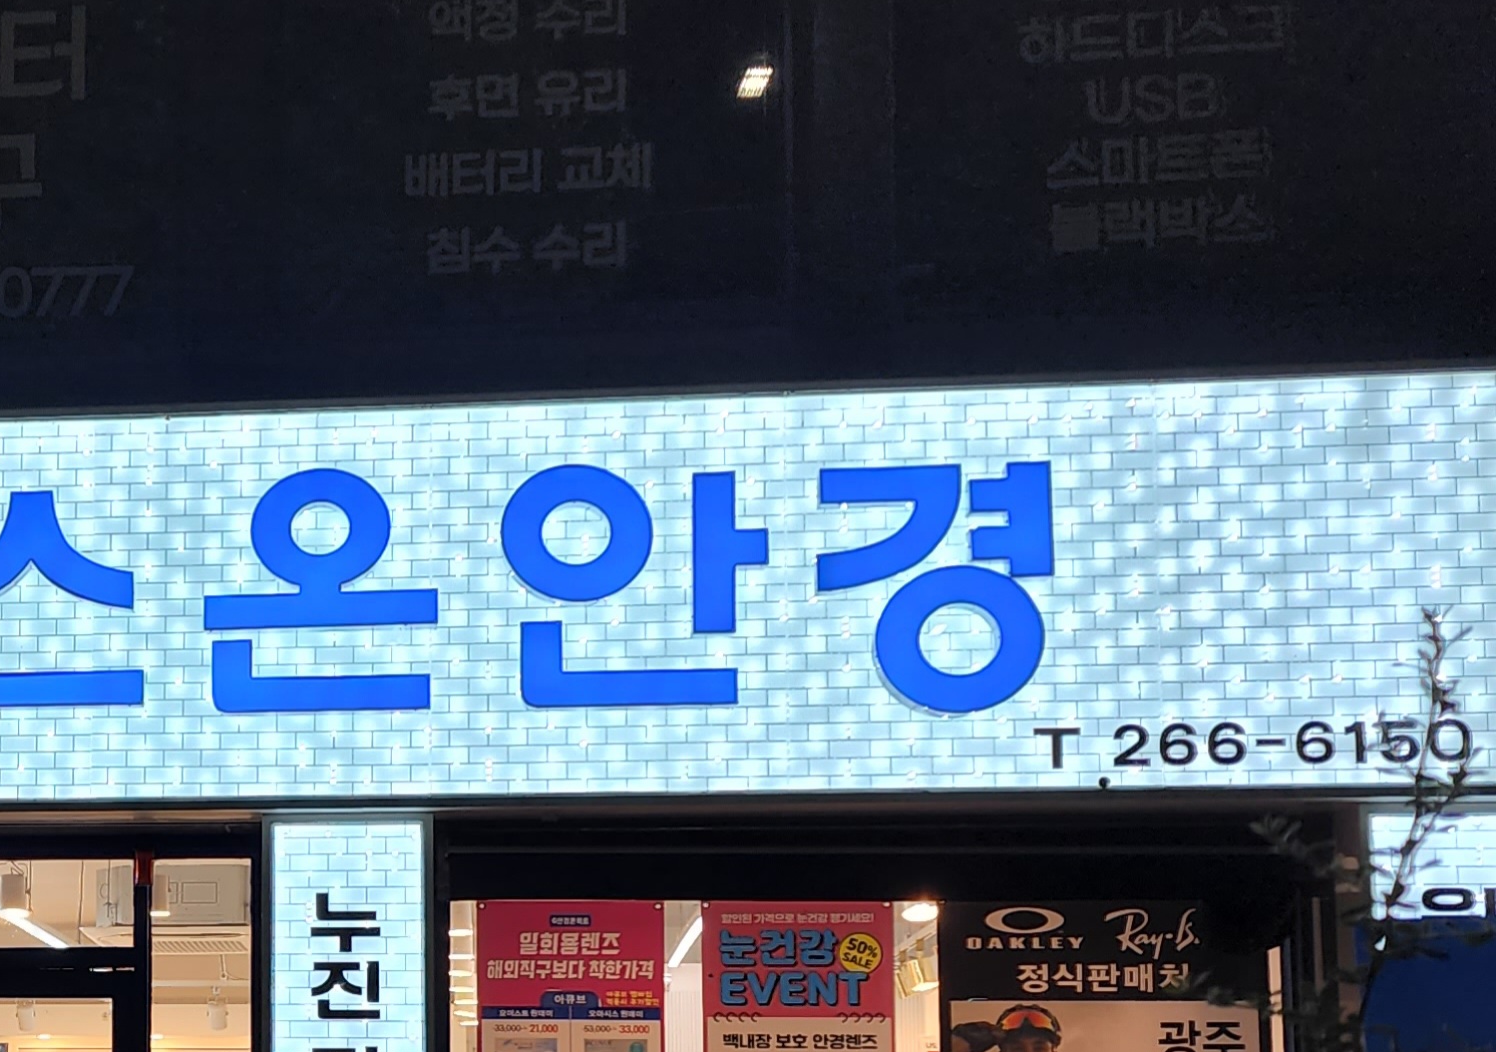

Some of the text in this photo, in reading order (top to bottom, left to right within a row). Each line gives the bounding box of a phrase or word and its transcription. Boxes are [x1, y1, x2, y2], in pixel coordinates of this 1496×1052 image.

[1018, 6, 1286, 64] 하드디스크
[428, 68, 626, 119] 후면 유리
[1086, 72, 1220, 125] USB
[405, 142, 654, 196] 배터리 교체
[1047, 128, 1271, 189] 스마트폰
[427, 221, 626, 275] 침수 수리
[1113, 718, 1474, 767] 266-6150
[754, 913, 795, 923] 가격으로
[310, 892, 382, 1021] 누진
[519, 932, 621, 955] 일회용렌즈
[719, 928, 838, 967] 눈건강
[846, 938, 878, 959] 50%
[965, 936, 1084, 950] OAKLEY
[487, 960, 655, 980] 해외직구보다 착한가격
[842, 952, 874, 970] SALE
[1016, 962, 1191, 994] 정식판매처
[554, 994, 586, 1004] 아큐브
[720, 971, 869, 1006] EVENT
[723, 1033, 878, 1050] 백내장 보호 안경렌즈
